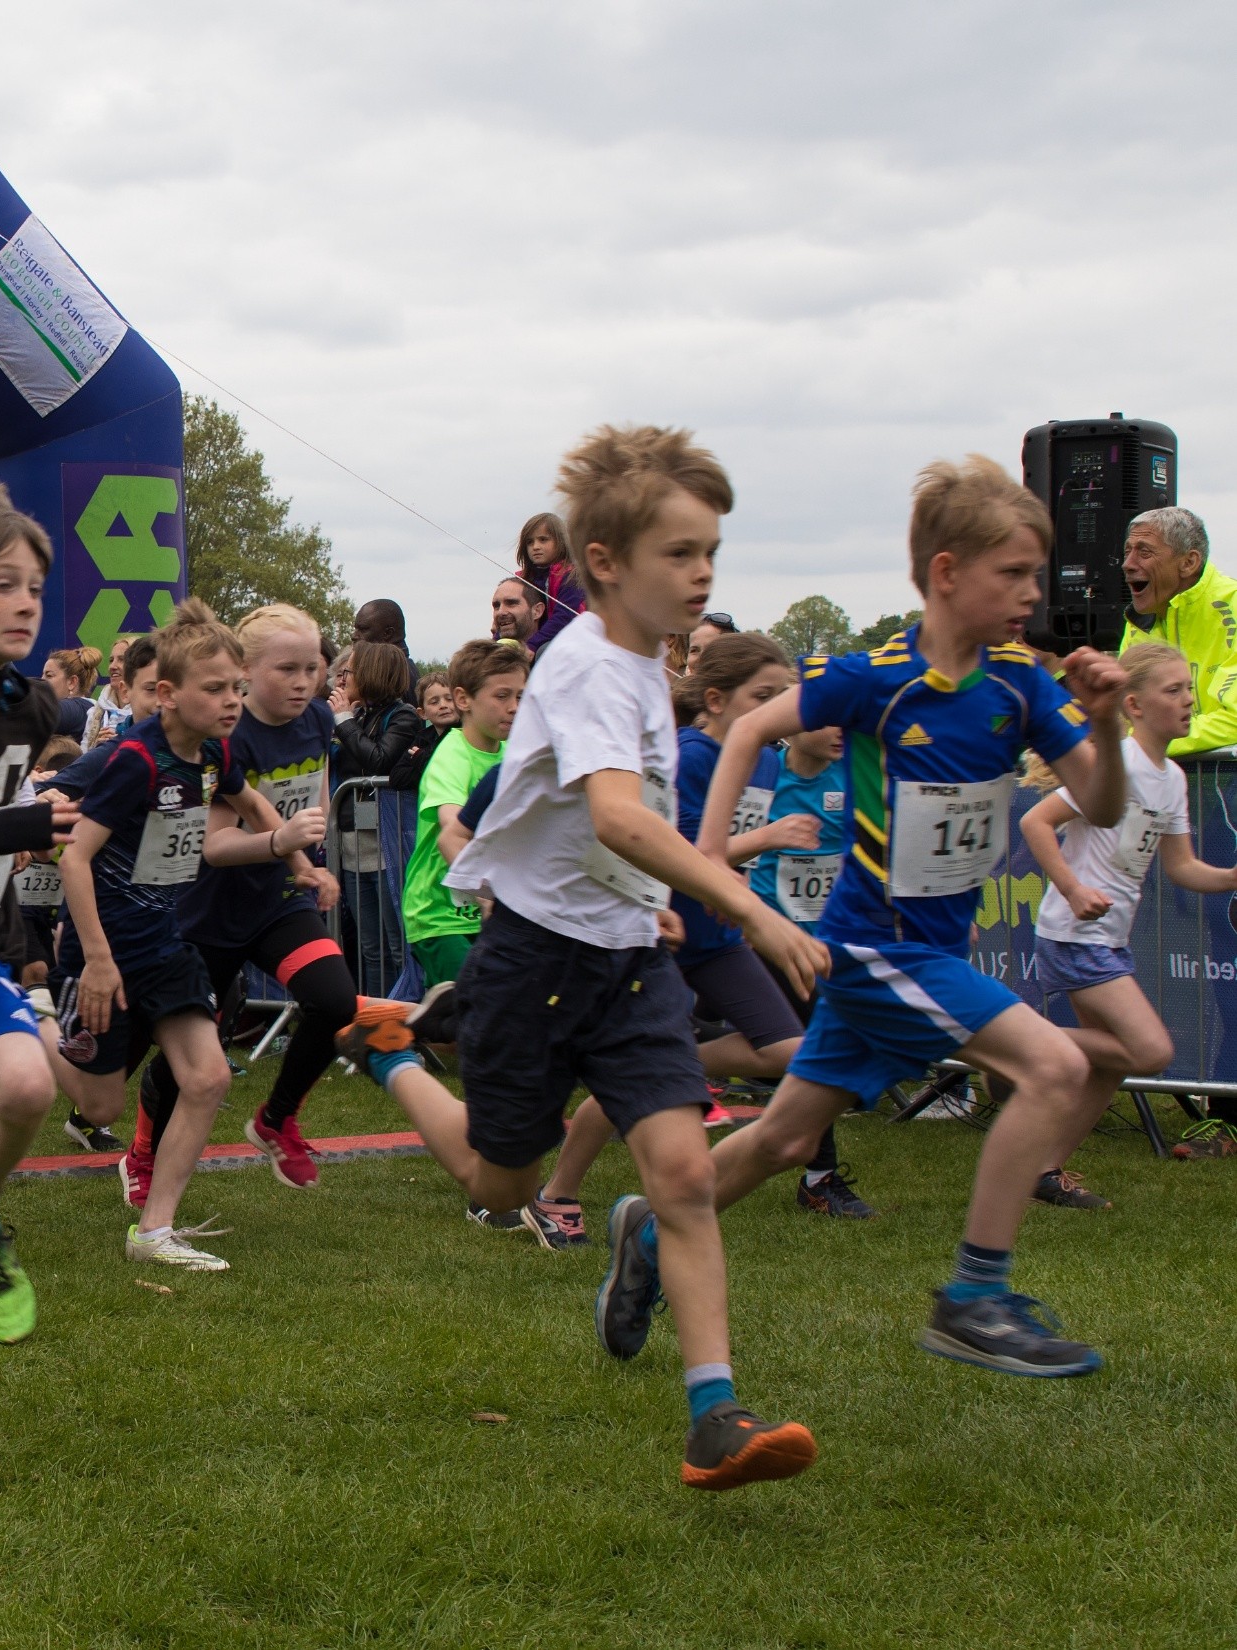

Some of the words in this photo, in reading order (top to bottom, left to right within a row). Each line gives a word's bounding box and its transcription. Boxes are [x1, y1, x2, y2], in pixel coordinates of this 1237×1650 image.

[1, 250, 53, 311] BOROUGH
[12, 238, 55, 289] Reigate
[61, 295, 110, 358] Banstead
[23, 293, 45, 320] Horley
[46, 321, 69, 347] Redhill
[68, 348, 89, 376] Reigate
[282, 789, 297, 798] FUN
[920, 785, 961, 797] YMCA
[945, 803, 970, 814] FUN
[175, 822, 190, 831] FUN
[932, 815, 993, 856] 141
[162, 830, 205, 858] 363
[1137, 831, 1163, 853] 52
[806, 867, 823, 875] FUN
[22, 877, 61, 892] 1233
[789, 877, 834, 899] 103
